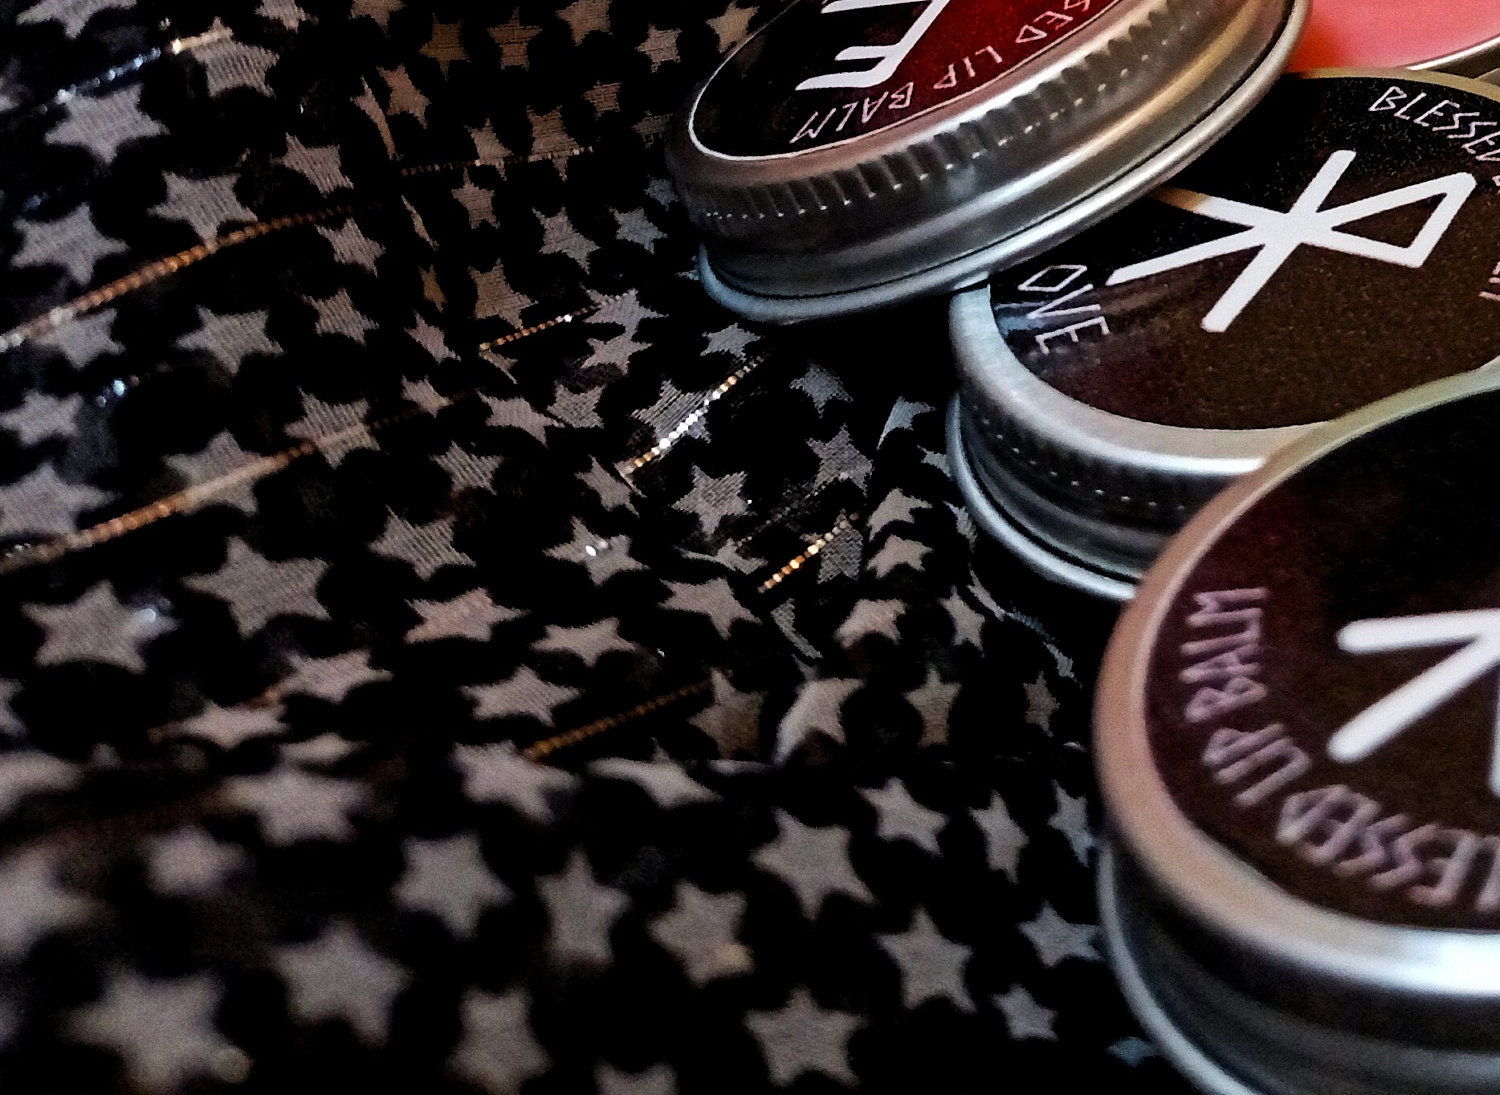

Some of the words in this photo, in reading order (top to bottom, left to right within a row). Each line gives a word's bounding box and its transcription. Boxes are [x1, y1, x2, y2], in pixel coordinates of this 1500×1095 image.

[933, 45, 1005, 91] LIP
[789, 81, 914, 144] BALM
[1018, 263, 1111, 354] OVE
[1180, 586, 1268, 723] BALM
[1203, 722, 1313, 807] LIP
